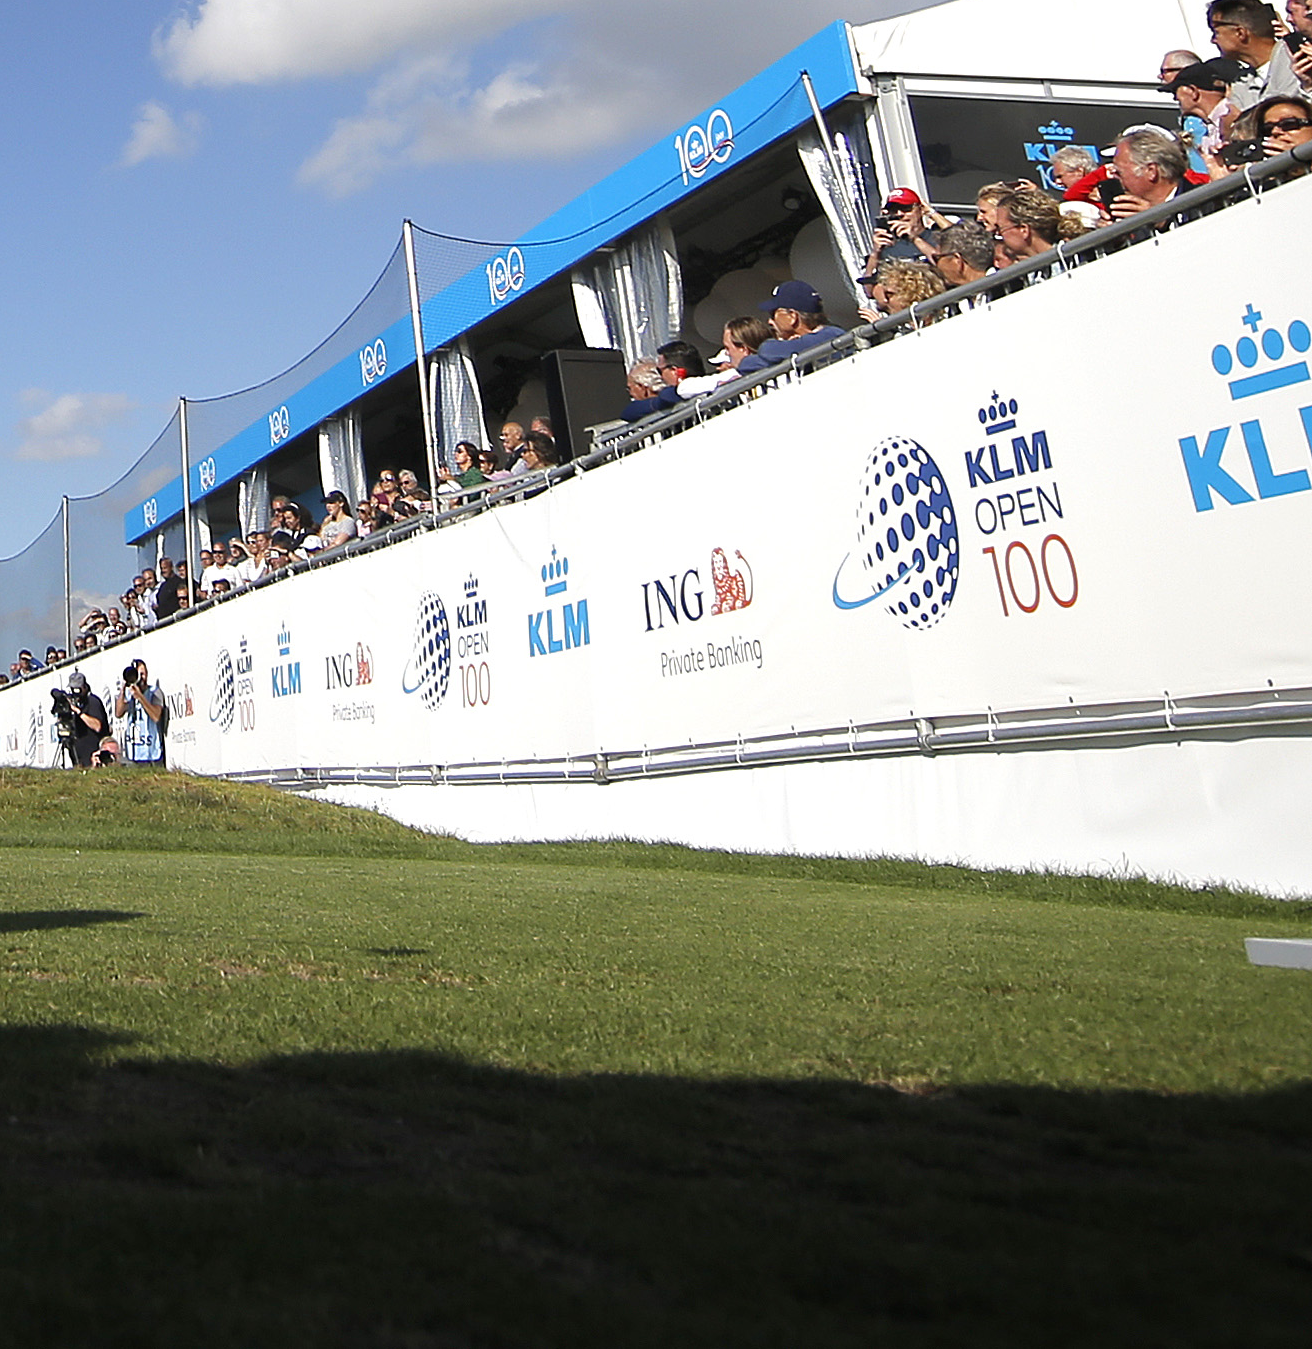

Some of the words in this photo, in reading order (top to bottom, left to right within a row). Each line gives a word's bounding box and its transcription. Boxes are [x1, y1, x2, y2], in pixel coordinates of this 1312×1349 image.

[674, 108, 734, 186] 100
[485, 246, 525, 305] 100
[359, 338, 387, 386] 100
[268, 405, 289, 446] 100
[964, 430, 1053, 488] KLM
[1178, 405, 1312, 512] KL
[975, 482, 1063, 534] OPEN
[982, 533, 1078, 617] 100
[457, 599, 487, 629] KLM
[641, 566, 704, 633] ING
[457, 630, 489, 658] OPEN
[527, 598, 590, 657] KLM
[237, 654, 252, 675] KLM
[325, 652, 353, 690] ING
[660, 647, 705, 677] Private
[706, 634, 763, 669] Banking
[271, 661, 301, 699] KLM
[459, 661, 491, 708] 100
[238, 698, 255, 732] 100
